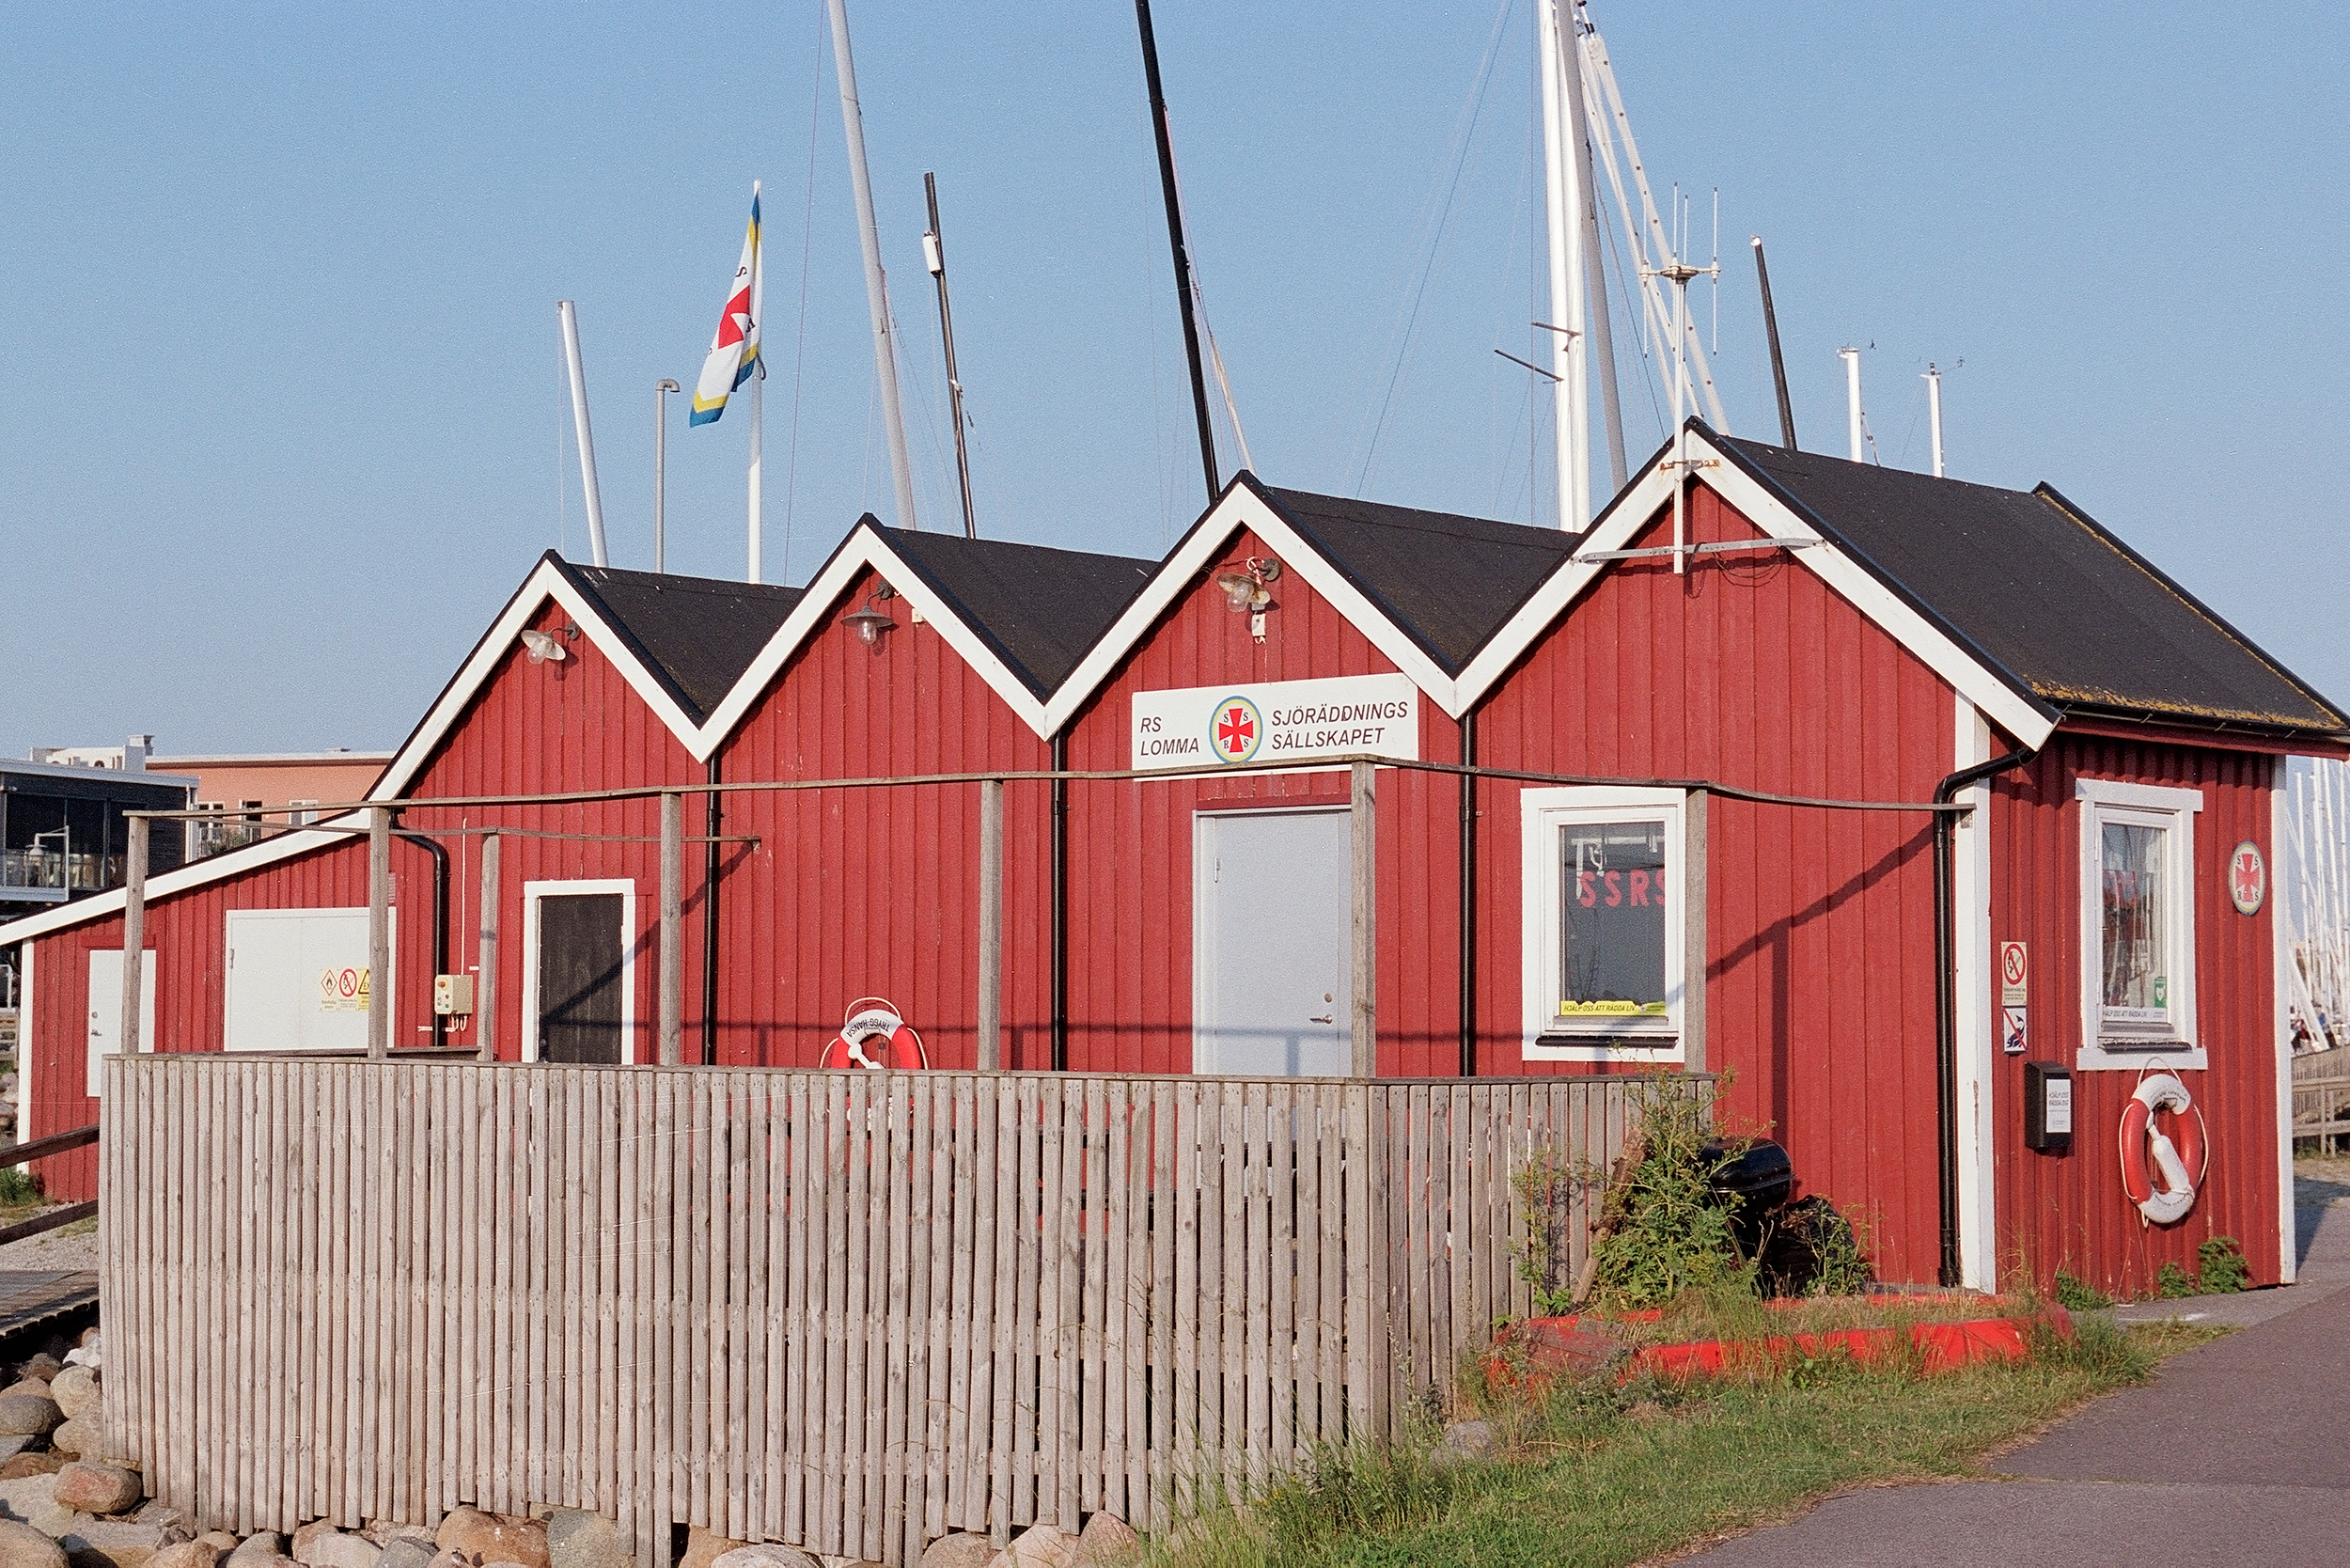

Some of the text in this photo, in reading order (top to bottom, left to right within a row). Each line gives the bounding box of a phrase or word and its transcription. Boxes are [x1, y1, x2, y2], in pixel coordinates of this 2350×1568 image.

[1223, 712, 1249, 724] S S
[1271, 701, 1408, 727] SJÖRÄDDNINGS
[1140, 716, 1162, 733] RS
[1140, 737, 1199, 756] LOMMA
[1223, 738, 1249, 749] R S
[1271, 727, 1386, 750] SÄLLSKAPET
[846, 1018, 890, 1038] TRYGG-HANSA
